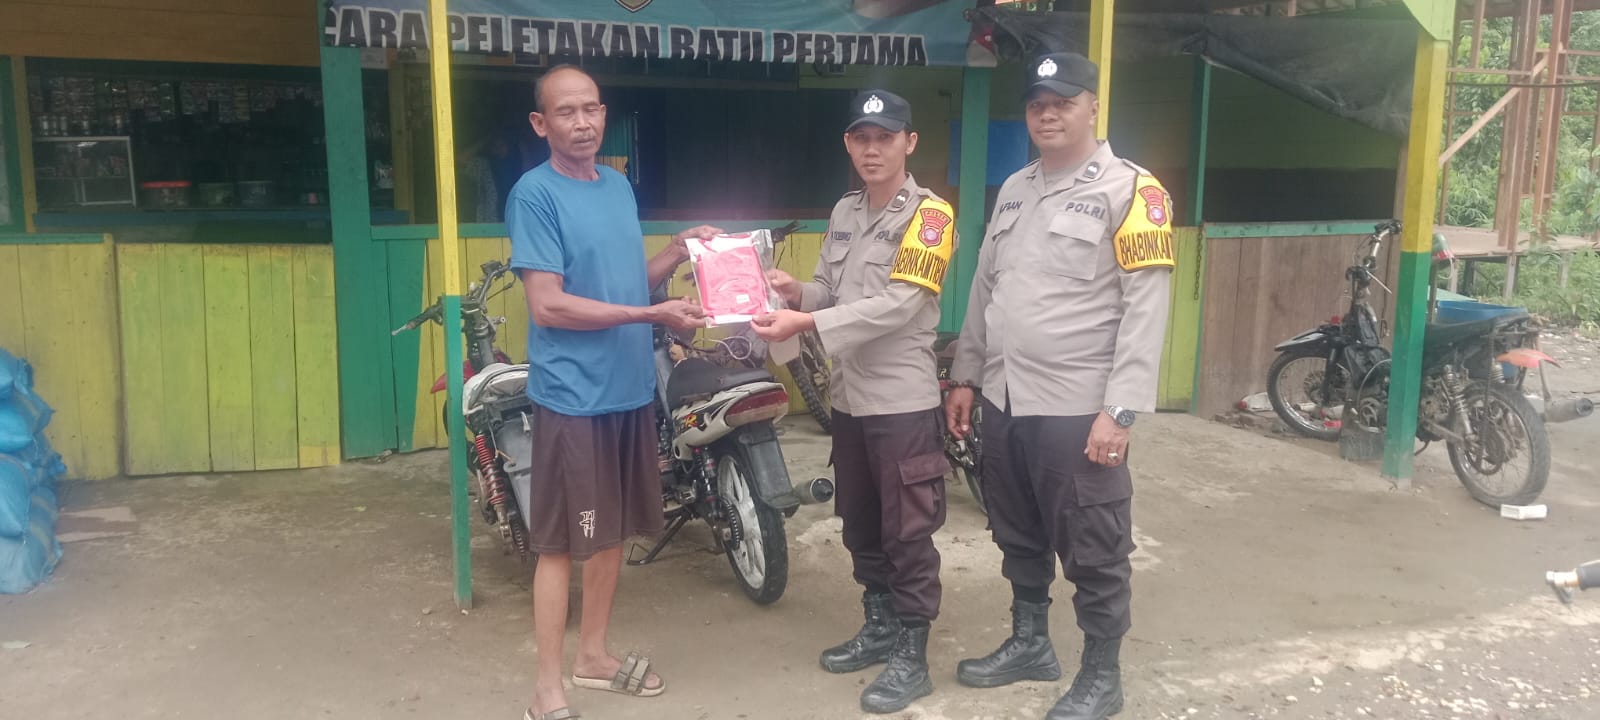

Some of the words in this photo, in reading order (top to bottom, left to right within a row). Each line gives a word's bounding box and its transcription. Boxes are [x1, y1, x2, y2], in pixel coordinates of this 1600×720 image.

[447, 12, 661, 58] PELETAKAN
[668, 24, 765, 61] BATU
[771, 29, 928, 66] PERTAMA
[1065, 202, 1106, 219] POLRI
